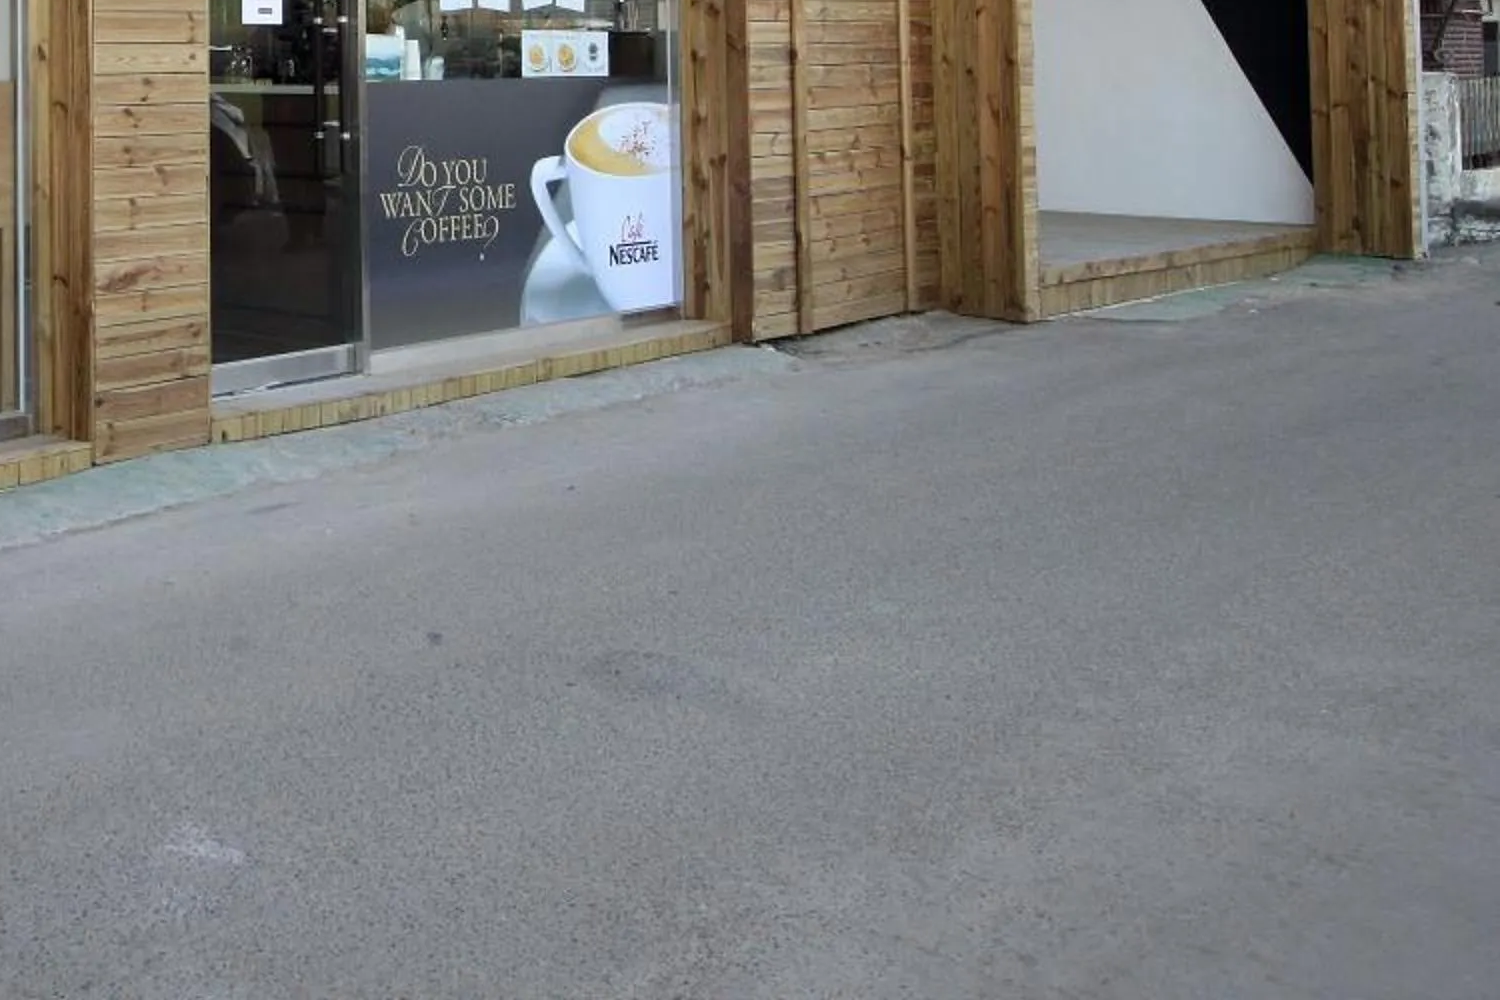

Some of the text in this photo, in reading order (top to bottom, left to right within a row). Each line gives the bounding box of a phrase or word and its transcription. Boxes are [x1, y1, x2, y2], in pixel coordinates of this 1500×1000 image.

[441, 158, 488, 185] YOU
[380, 183, 517, 218] WANT SOME
